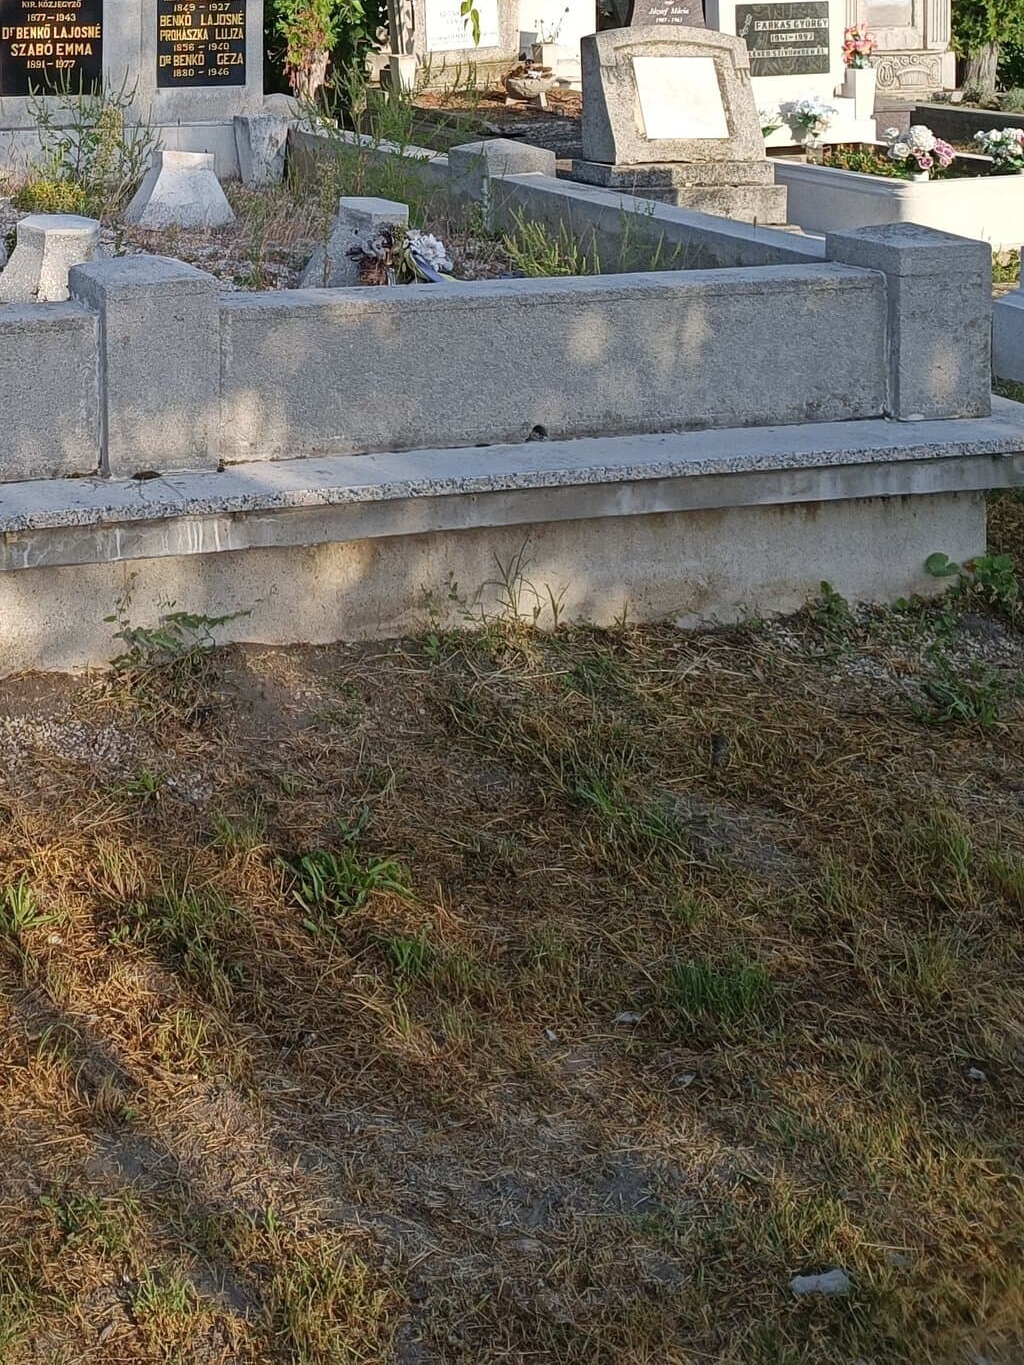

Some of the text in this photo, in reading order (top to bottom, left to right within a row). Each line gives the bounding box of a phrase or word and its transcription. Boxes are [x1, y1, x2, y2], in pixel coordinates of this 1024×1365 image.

[209, 2, 231, 11] 1927
[200, 10, 245, 26] LAJOSNÉ
[755, 17, 827, 30] FARKAS GYÖRGY
[16, 24, 51, 39] BENKŐ
[53, 23, 101, 38] LAJOSNÉ
[215, 28, 244, 40] LUJZA
[11, 40, 92, 56] SZABÓ EMMA
